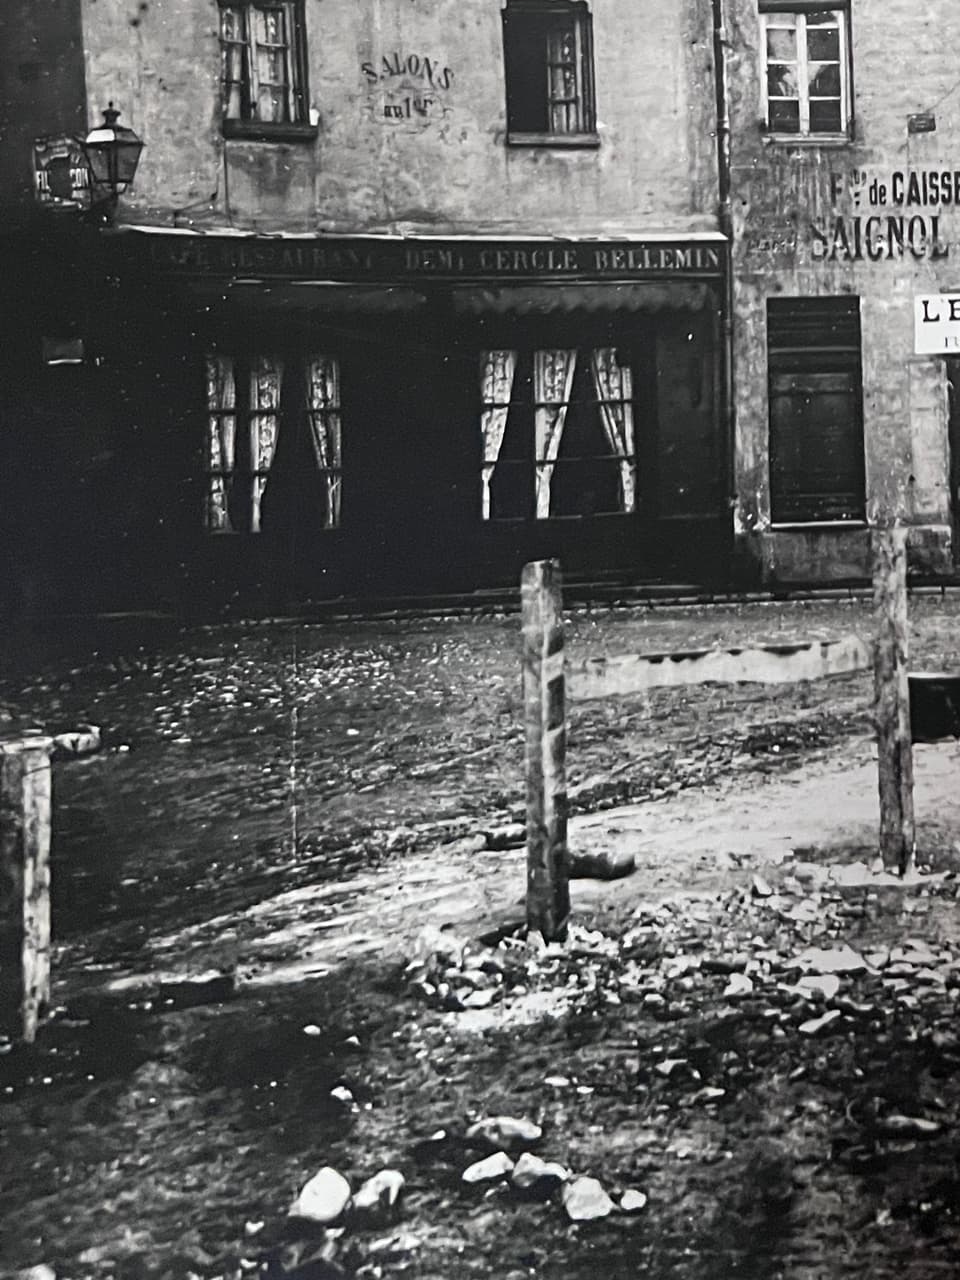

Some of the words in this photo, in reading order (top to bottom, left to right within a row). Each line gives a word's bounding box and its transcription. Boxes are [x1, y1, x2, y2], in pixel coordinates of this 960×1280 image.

[361, 52, 455, 91] SALONS
[869, 178, 887, 206] de
[811, 214, 949, 262] SAIGNOL
[480, 248, 578, 271] CERCLE
[595, 246, 719, 270] BELLEMIN
